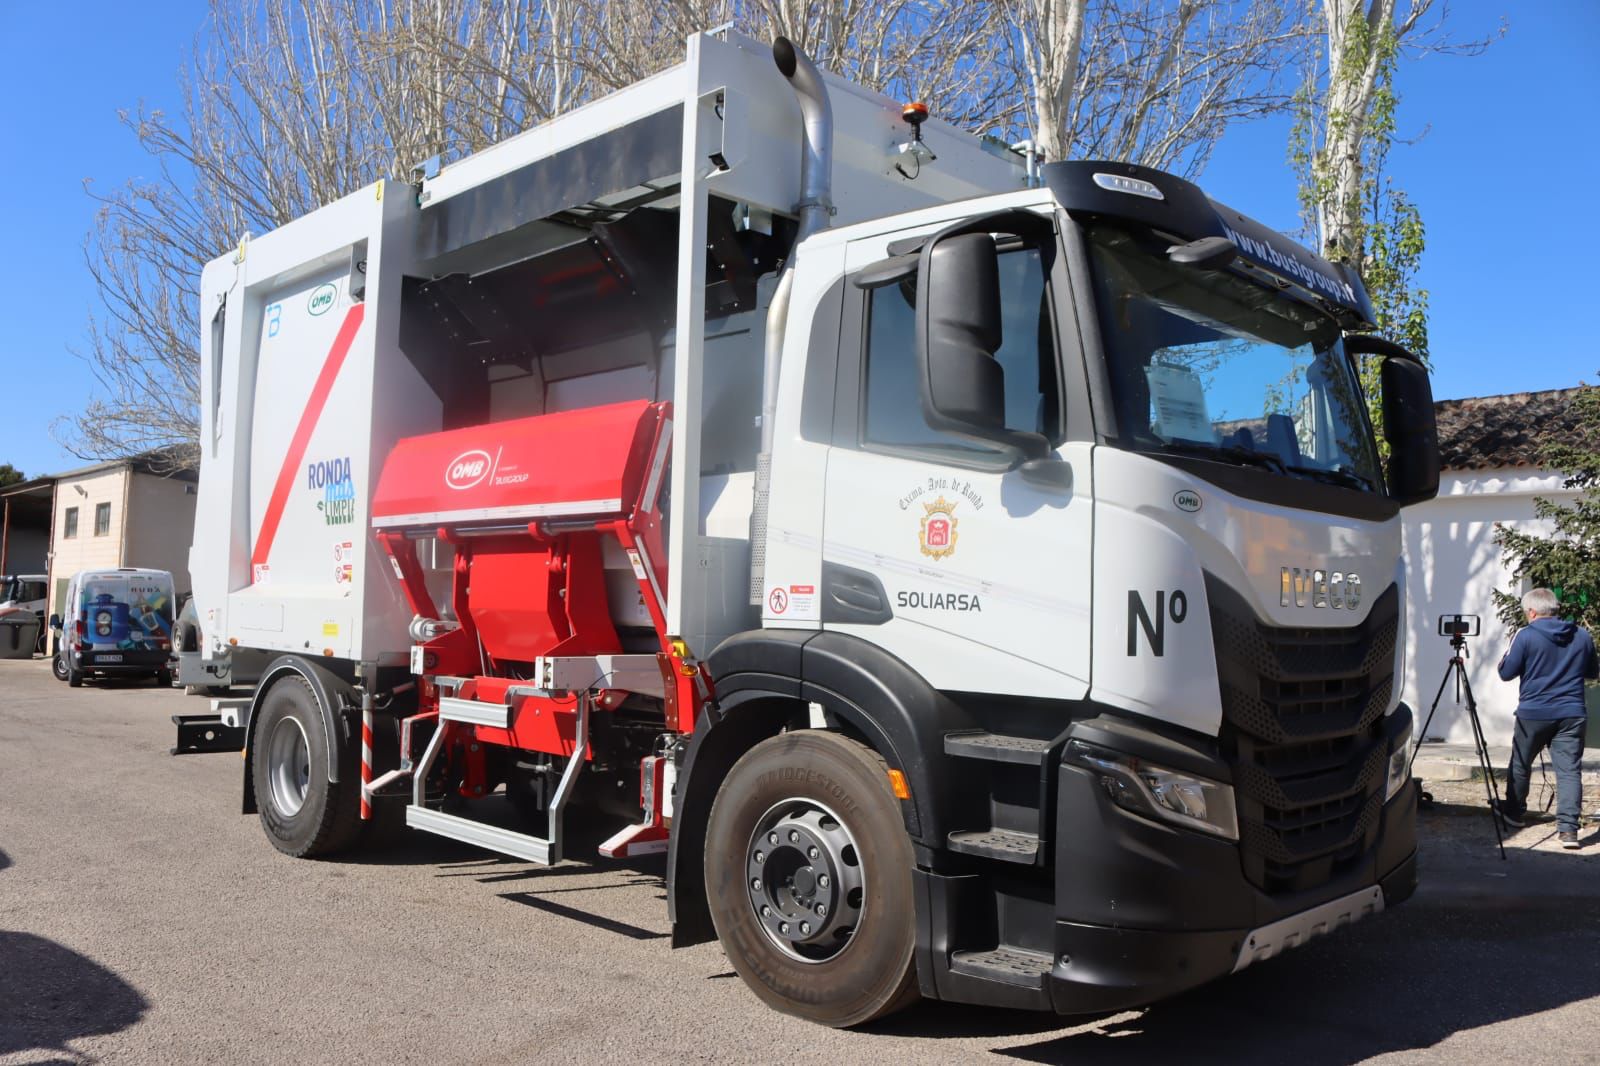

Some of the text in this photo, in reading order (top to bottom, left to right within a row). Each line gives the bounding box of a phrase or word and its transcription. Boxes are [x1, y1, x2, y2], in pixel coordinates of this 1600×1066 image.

[1221, 219, 1358, 304] www.busigroup.it
[308, 456, 351, 490] RONDA
[452, 460, 485, 480] OMB
[961, 481, 984, 511] Ronda
[1178, 495, 1199, 507] OMB
[897, 591, 982, 612] SOLIARSA
[1279, 566, 1362, 610] IVECO
